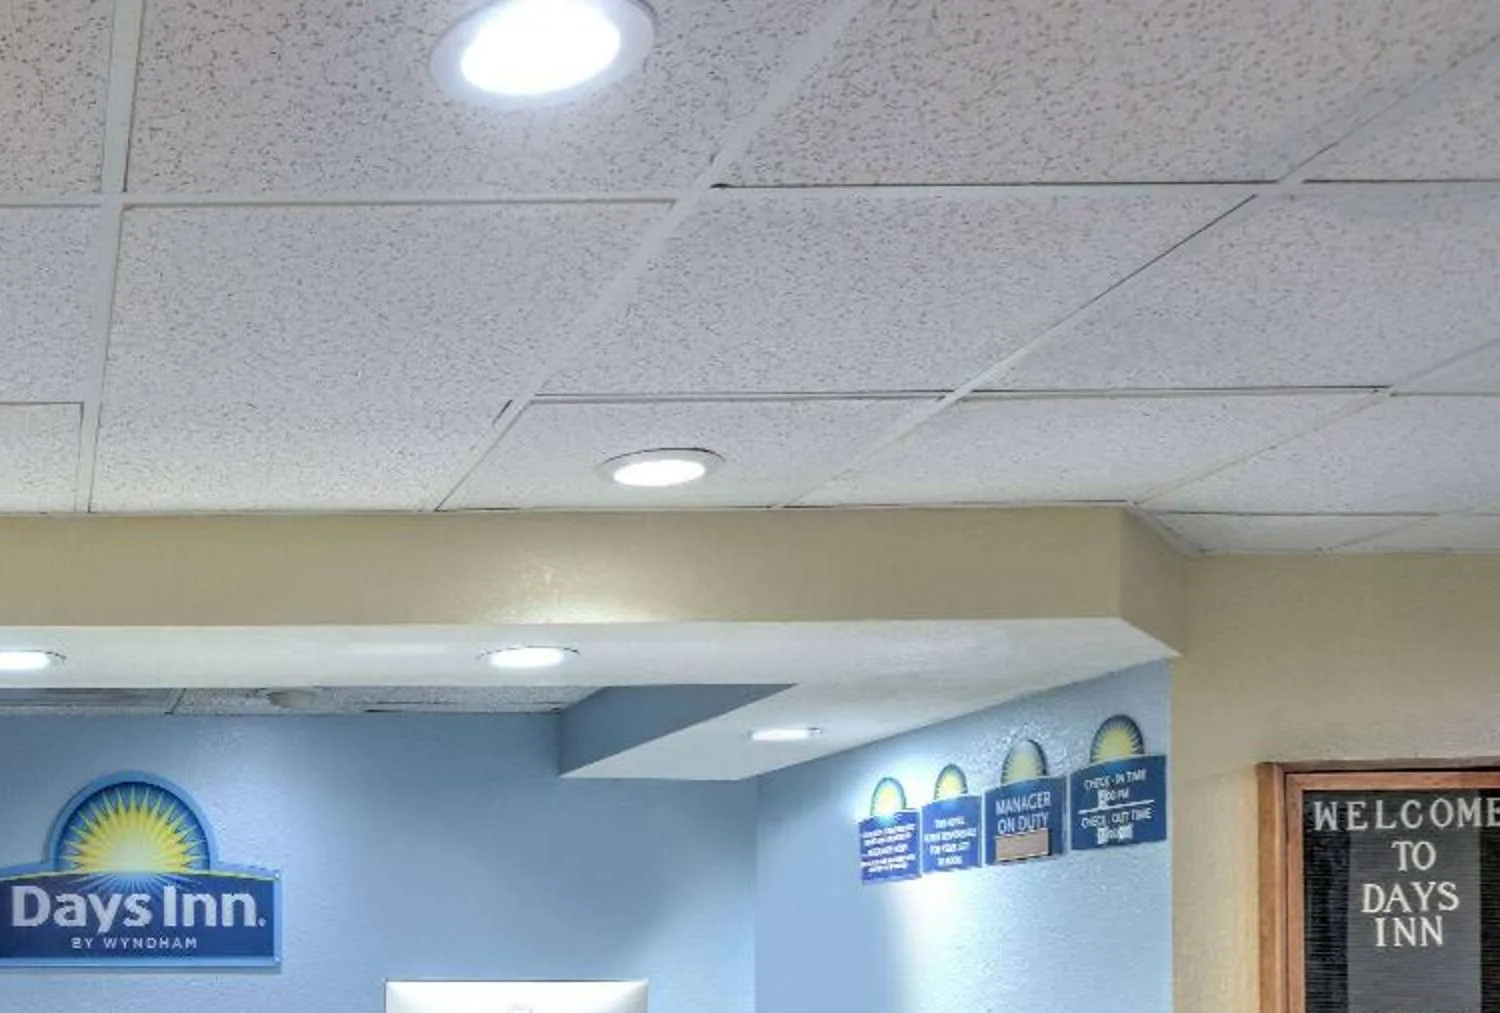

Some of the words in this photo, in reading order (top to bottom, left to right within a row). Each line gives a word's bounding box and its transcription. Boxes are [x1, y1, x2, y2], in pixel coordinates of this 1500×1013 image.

[995, 791, 1052, 815] MANAGER
[1313, 797, 1500, 831] WELCOME
[997, 816, 1015, 835] ON
[1017, 811, 1050, 831] DUTY
[1391, 840, 1437, 872] TO
[11, 885, 153, 934] Days
[1361, 881, 1461, 914] DAYS
[71, 936, 94, 949] BY
[103, 936, 197, 949] WYNDHAM
[1374, 915, 1444, 947] INN
